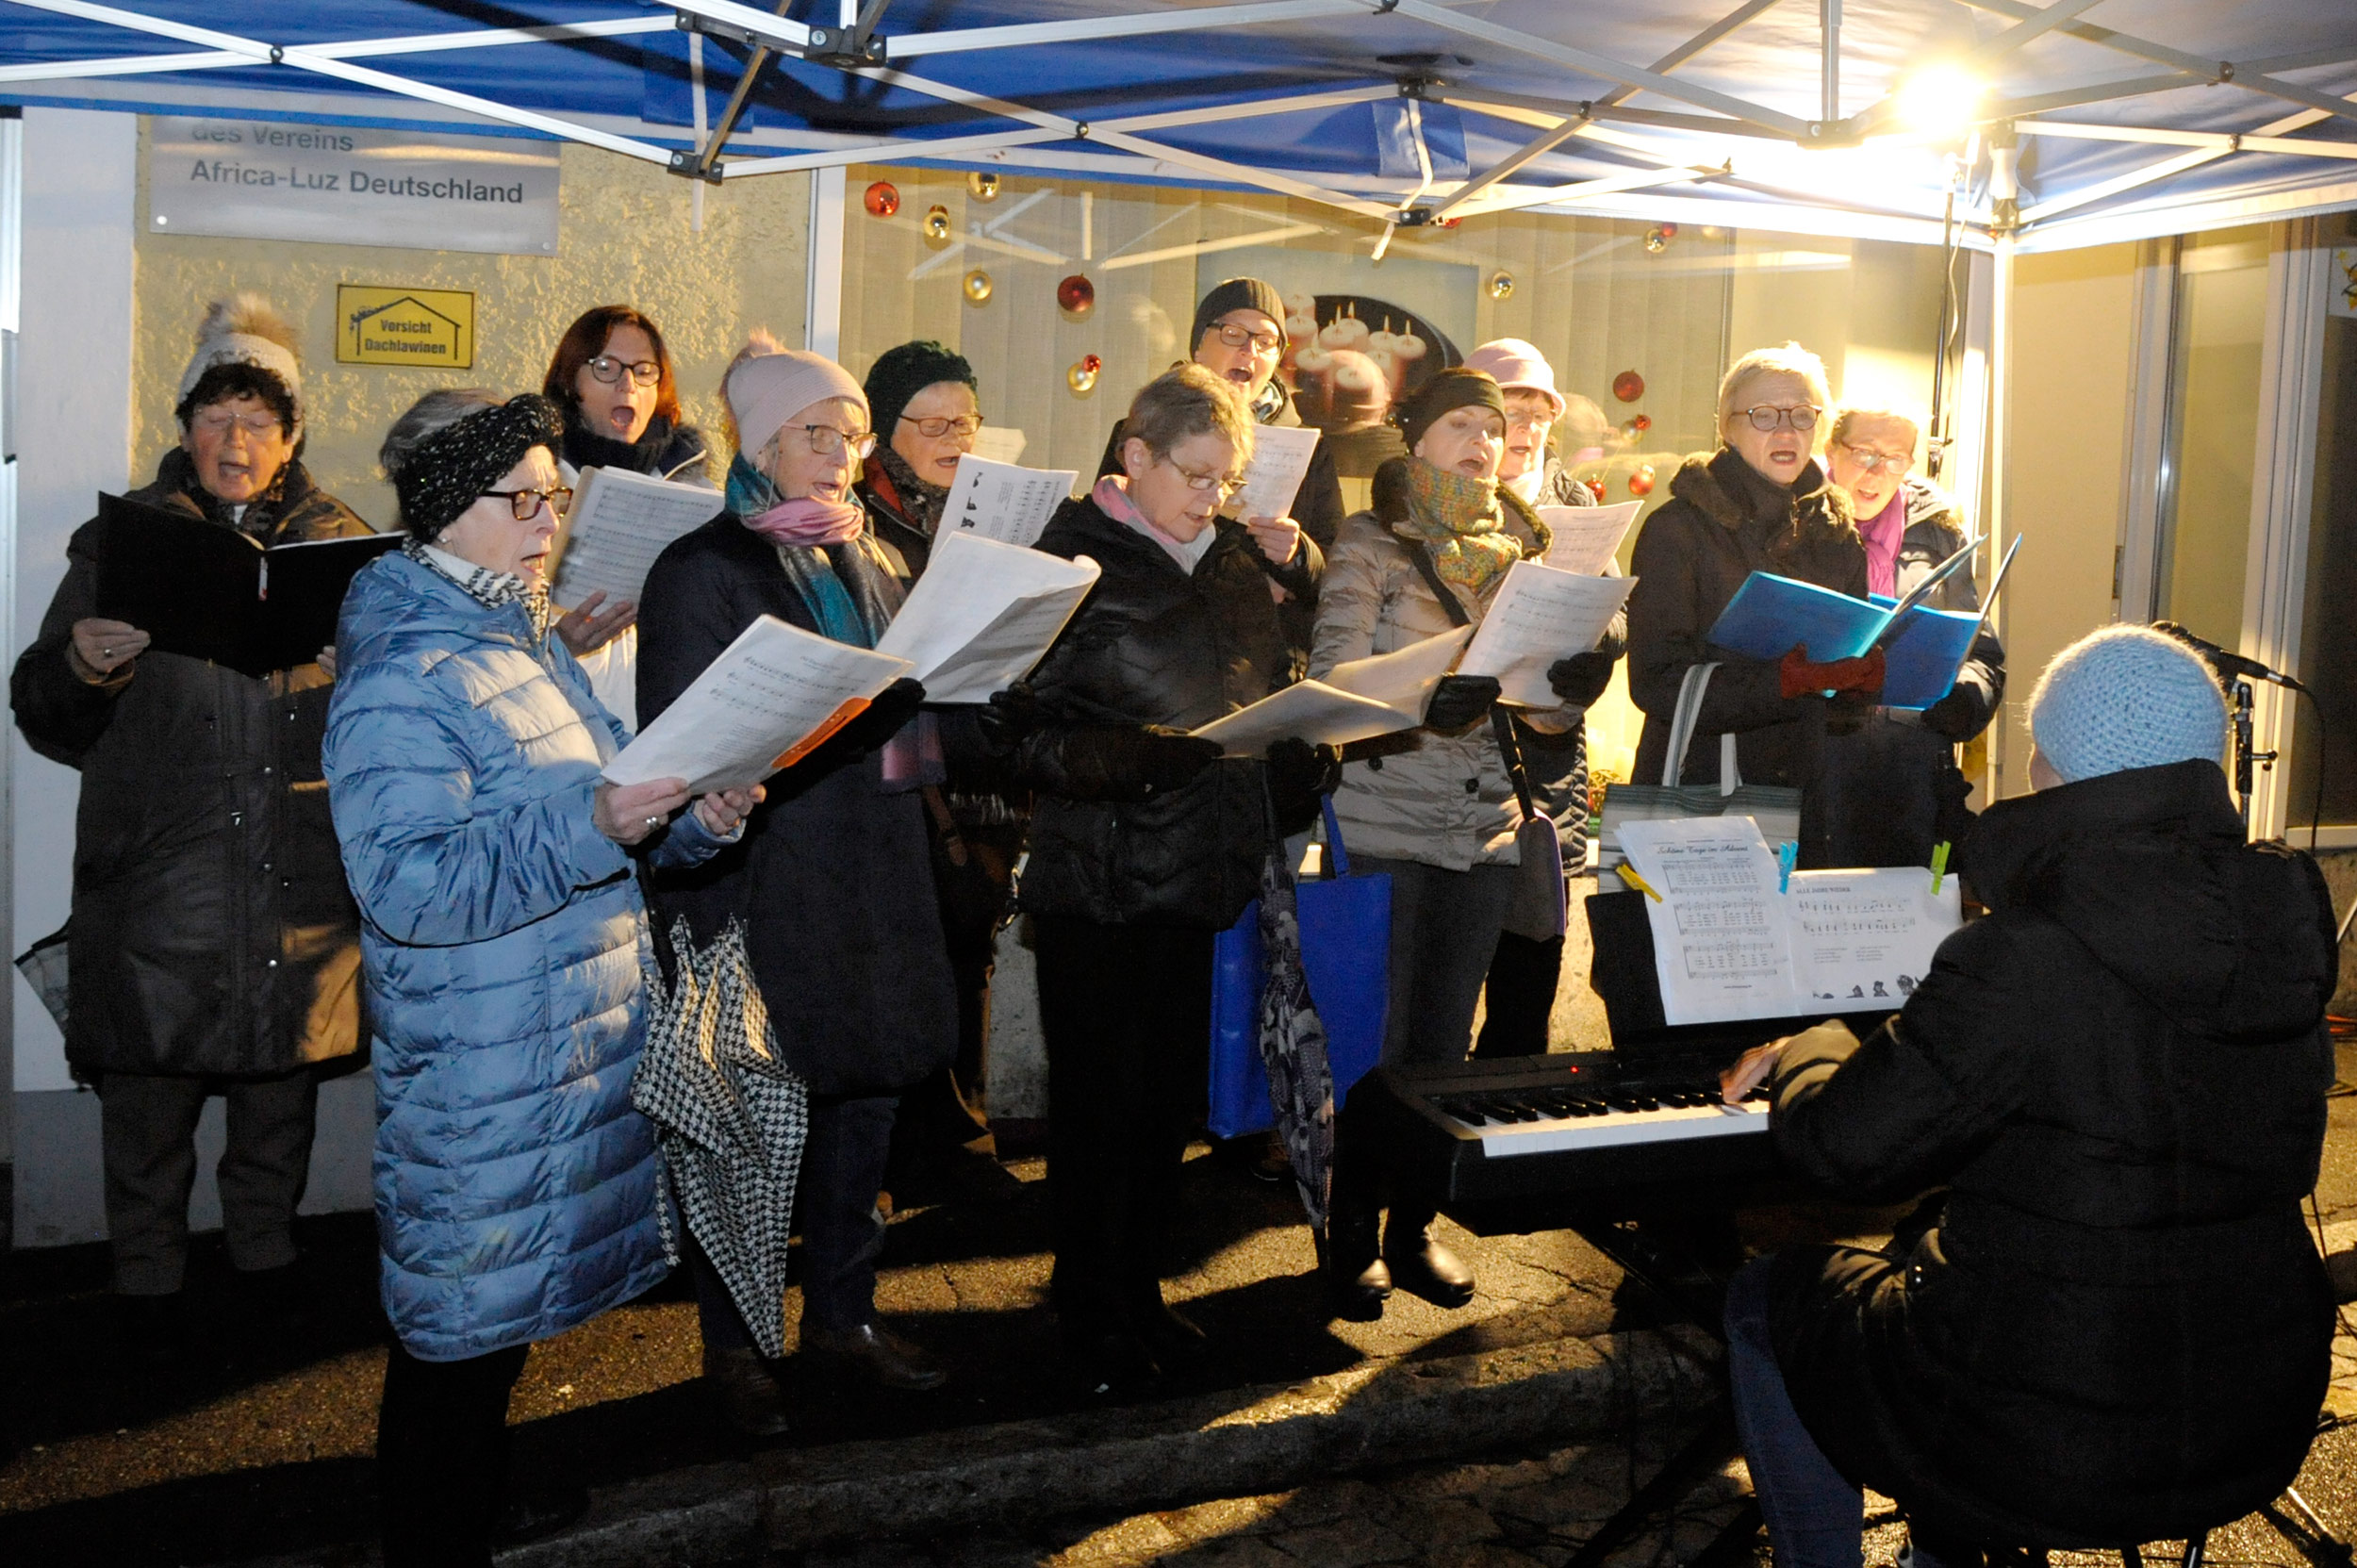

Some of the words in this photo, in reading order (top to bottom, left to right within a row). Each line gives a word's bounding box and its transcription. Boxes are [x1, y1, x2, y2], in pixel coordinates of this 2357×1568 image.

[253, 126, 354, 152] Vereins
[190, 159, 340, 190] Africa-Luz
[350, 171, 523, 204] Deutschland
[380, 319, 432, 334] Vorsicht
[365, 338, 446, 355] Dachlawinen
